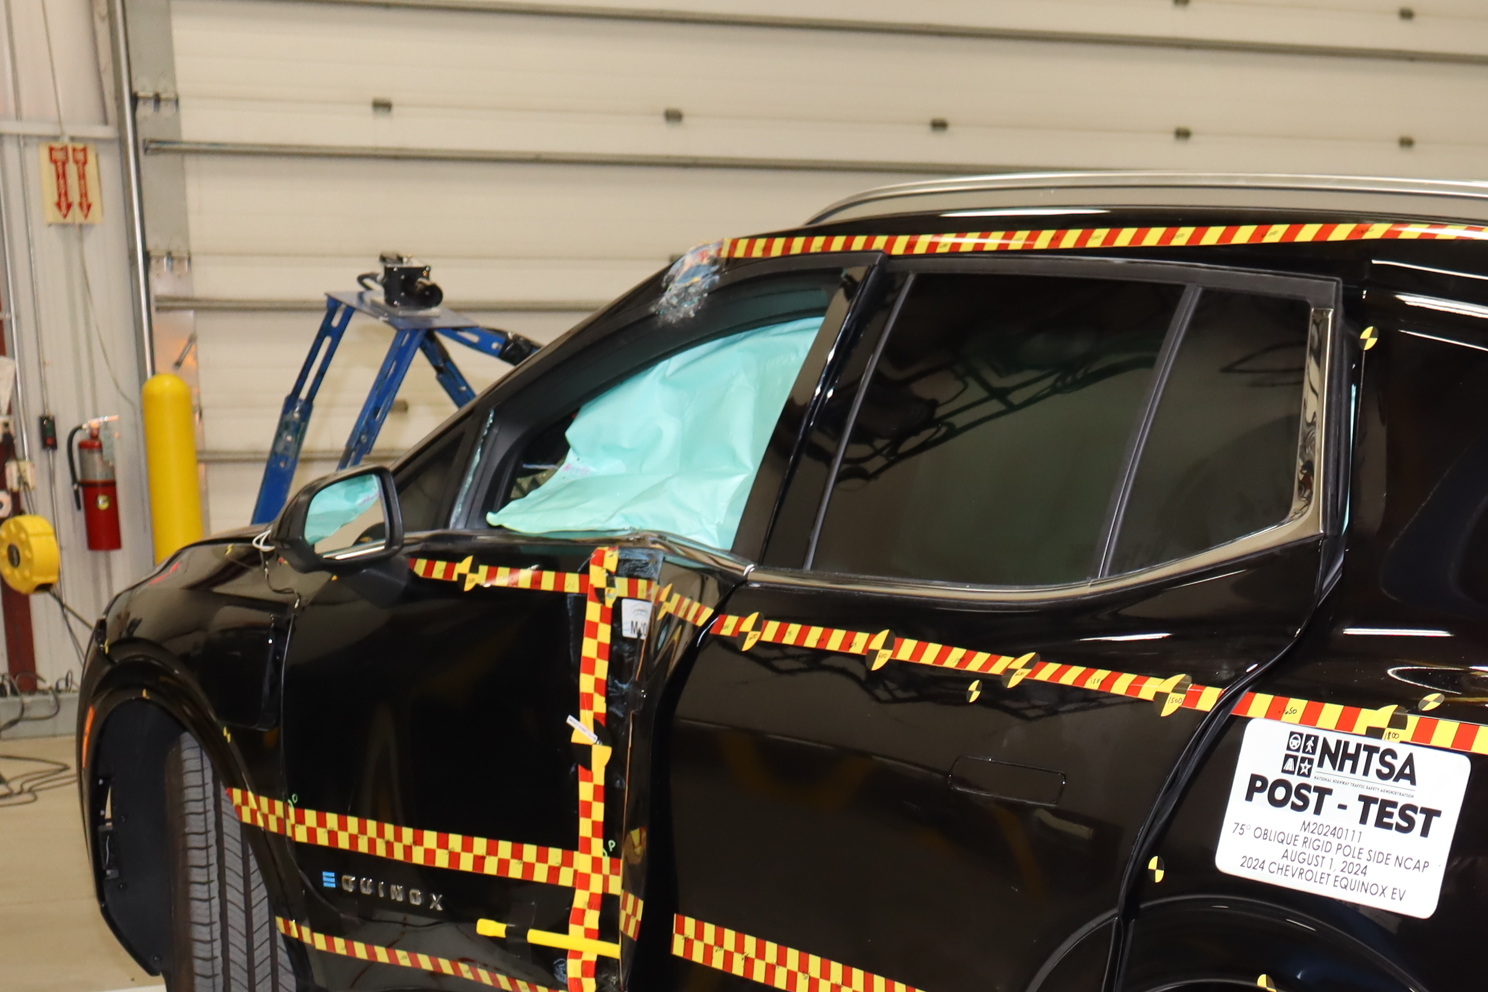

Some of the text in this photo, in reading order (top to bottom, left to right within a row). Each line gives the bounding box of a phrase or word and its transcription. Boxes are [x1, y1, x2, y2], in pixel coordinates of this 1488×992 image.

[1317, 737, 1417, 786] NHTSA
[1245, 773, 1333, 816] POST
[1357, 794, 1442, 838] TEST
[1253, 826, 1300, 847] OBLIQUE
[1301, 836, 1333, 853] RIGID
[1335, 842, 1364, 860] POLE
[1366, 849, 1392, 866] SIDE
[1393, 855, 1430, 873] NCAP
[1299, 820, 1362, 843] M20240111
[1239, 855, 1407, 902] 2024 CHEVROLET EQUINOX EV
[1280, 848, 1368, 877] AUGUST 1, 2024
[322, 871, 443, 911] EQUINOX
